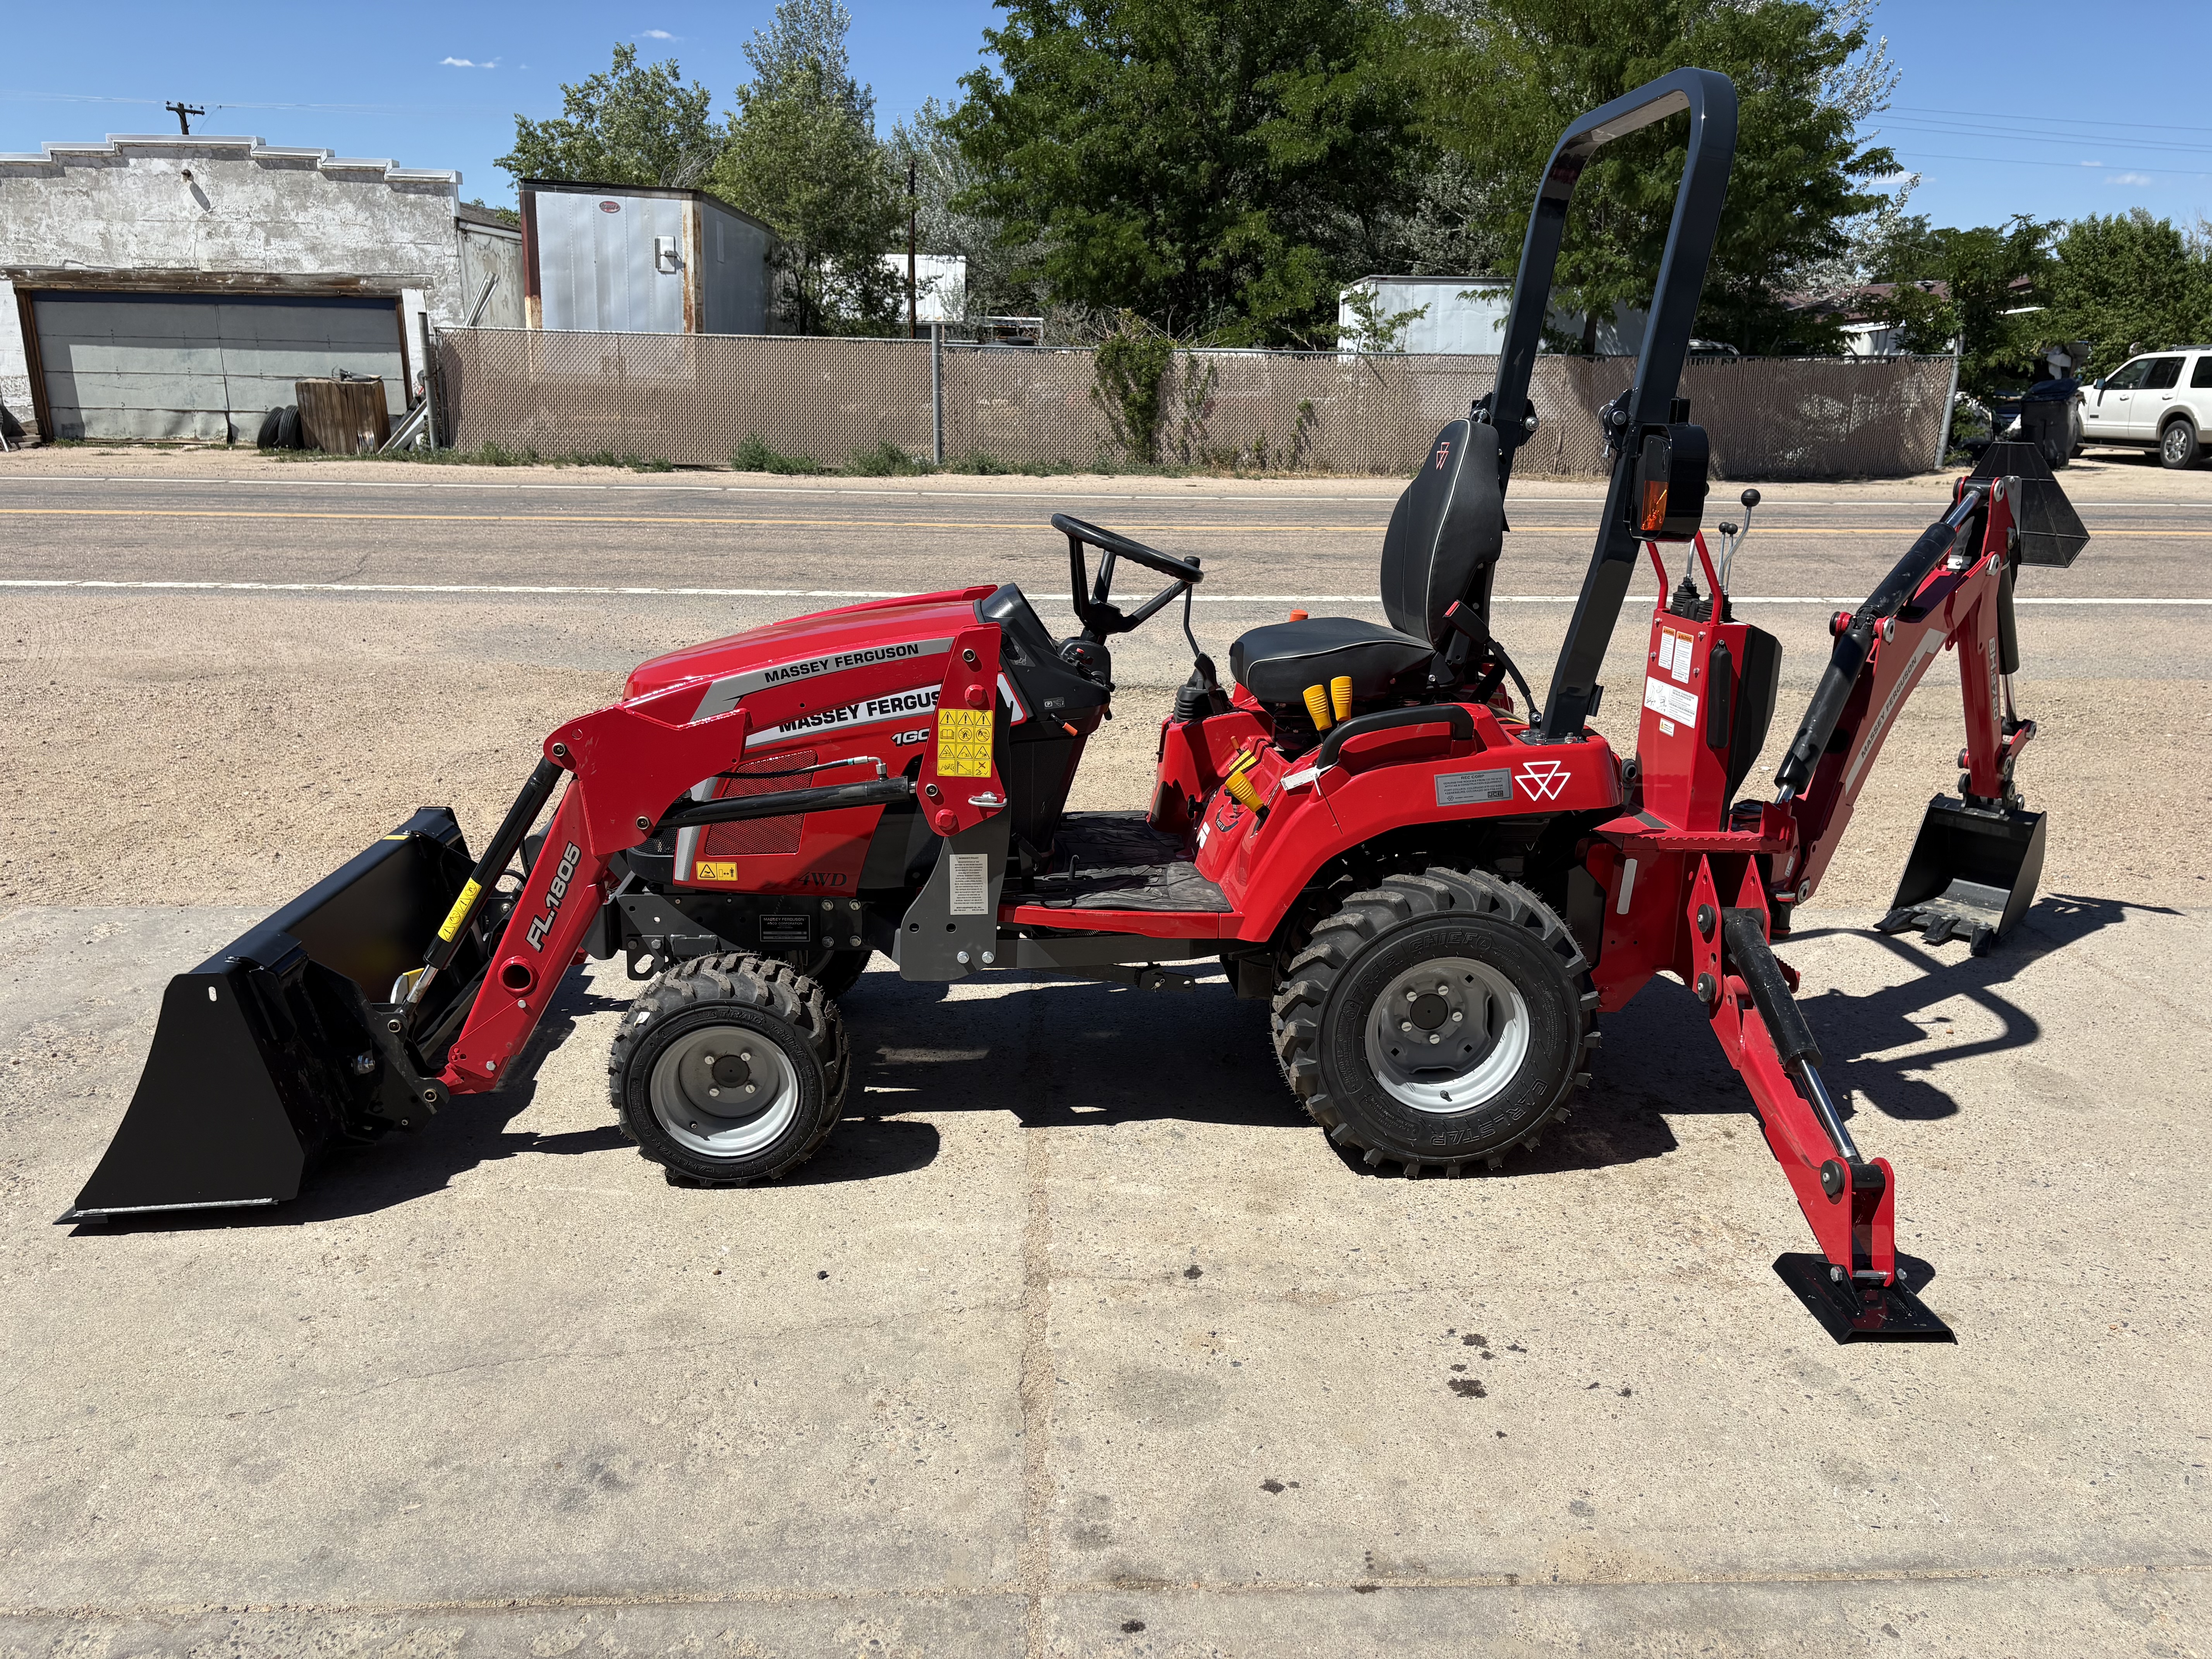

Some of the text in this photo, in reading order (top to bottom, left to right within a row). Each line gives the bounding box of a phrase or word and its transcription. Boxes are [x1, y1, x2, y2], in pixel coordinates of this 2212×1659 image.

[764, 644, 919, 683] MASSEY FERGUSON
[1989, 637, 1999, 721] BH.2720
[779, 691, 940, 733] MASSEY FERGUS
[1861, 656, 1917, 759] MASSEY FERGUSON
[525, 841, 581, 952] FL.1805
[798, 871, 847, 886] 4WD
[1350, 931, 1479, 1001] TRAC CHIEF
[718, 1009, 764, 1025] TRAC
[651, 1138, 715, 1173] CARLSTAR
